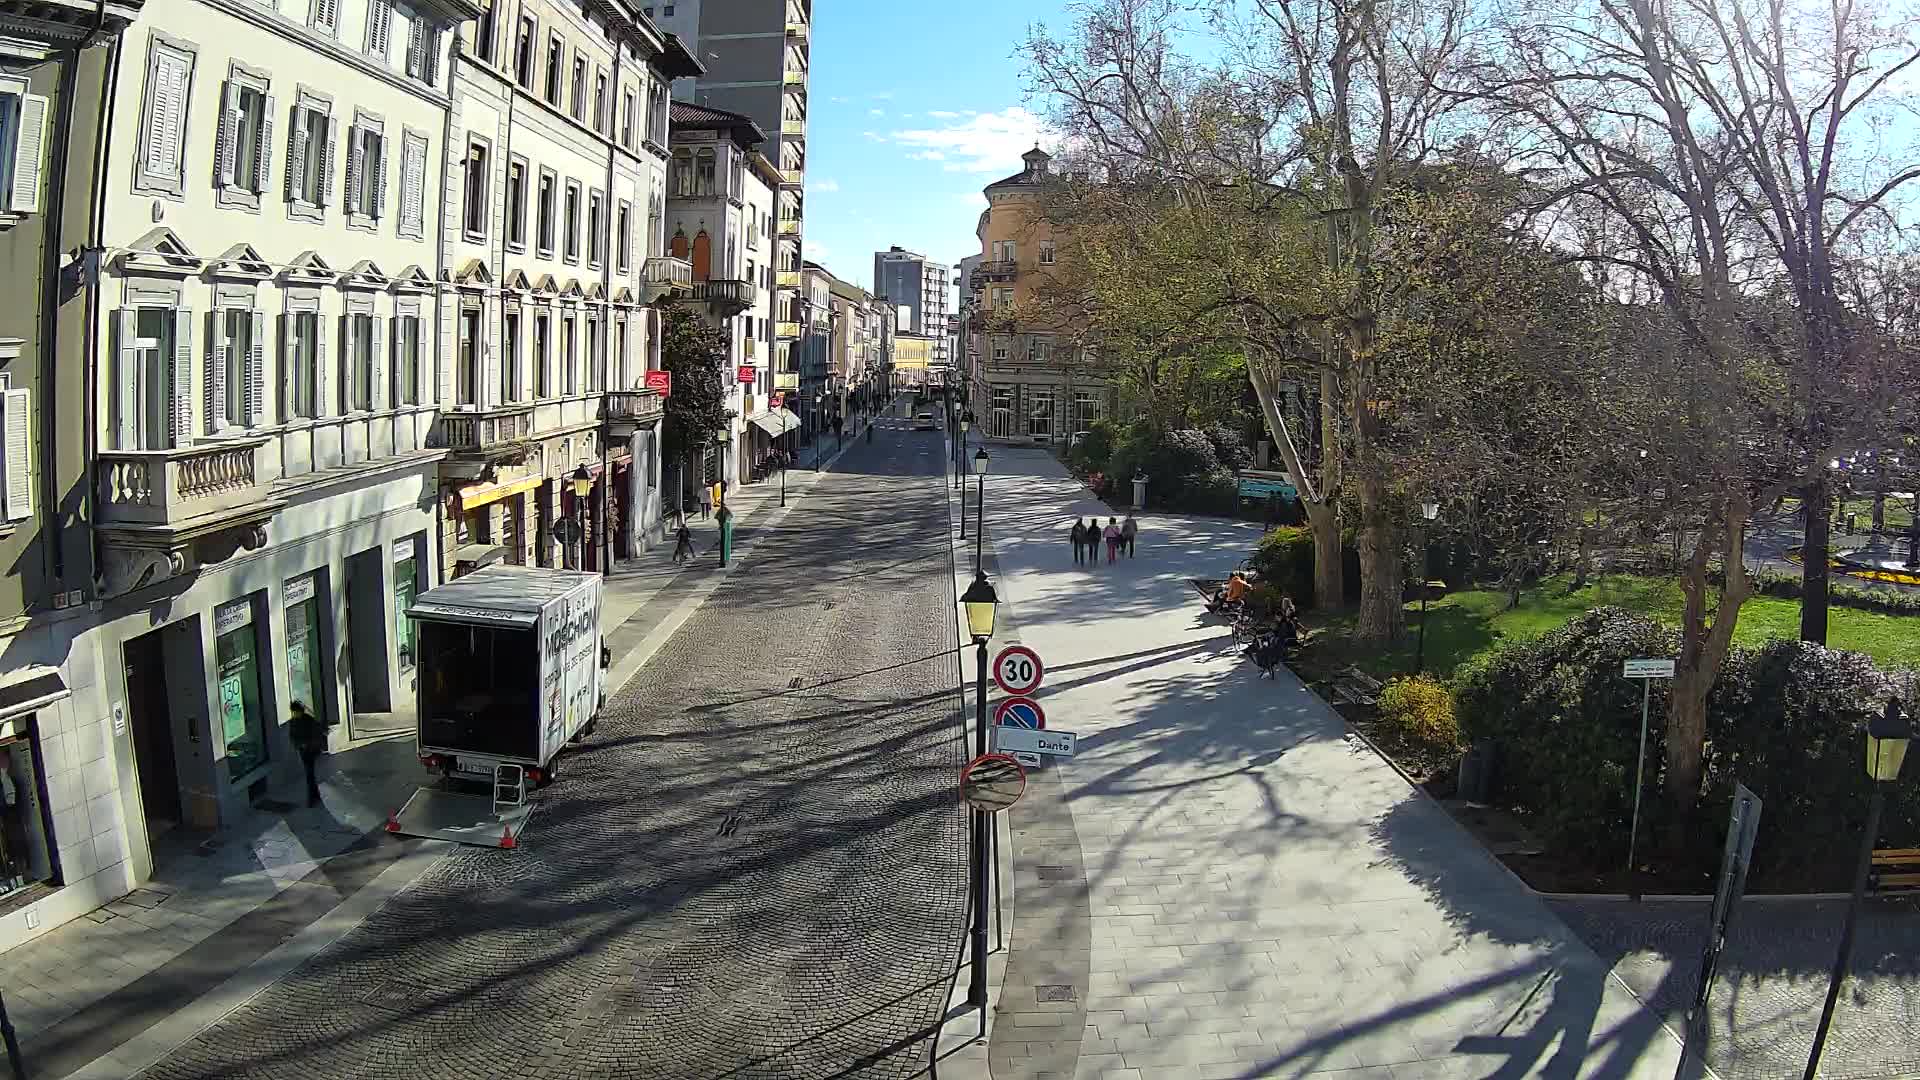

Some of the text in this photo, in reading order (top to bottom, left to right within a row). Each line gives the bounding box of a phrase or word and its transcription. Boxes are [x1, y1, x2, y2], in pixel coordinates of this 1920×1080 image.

[545, 606, 593, 662] MOSCHION
[1005, 660, 1033, 682] 30
[1038, 740, 1070, 751] Dante
